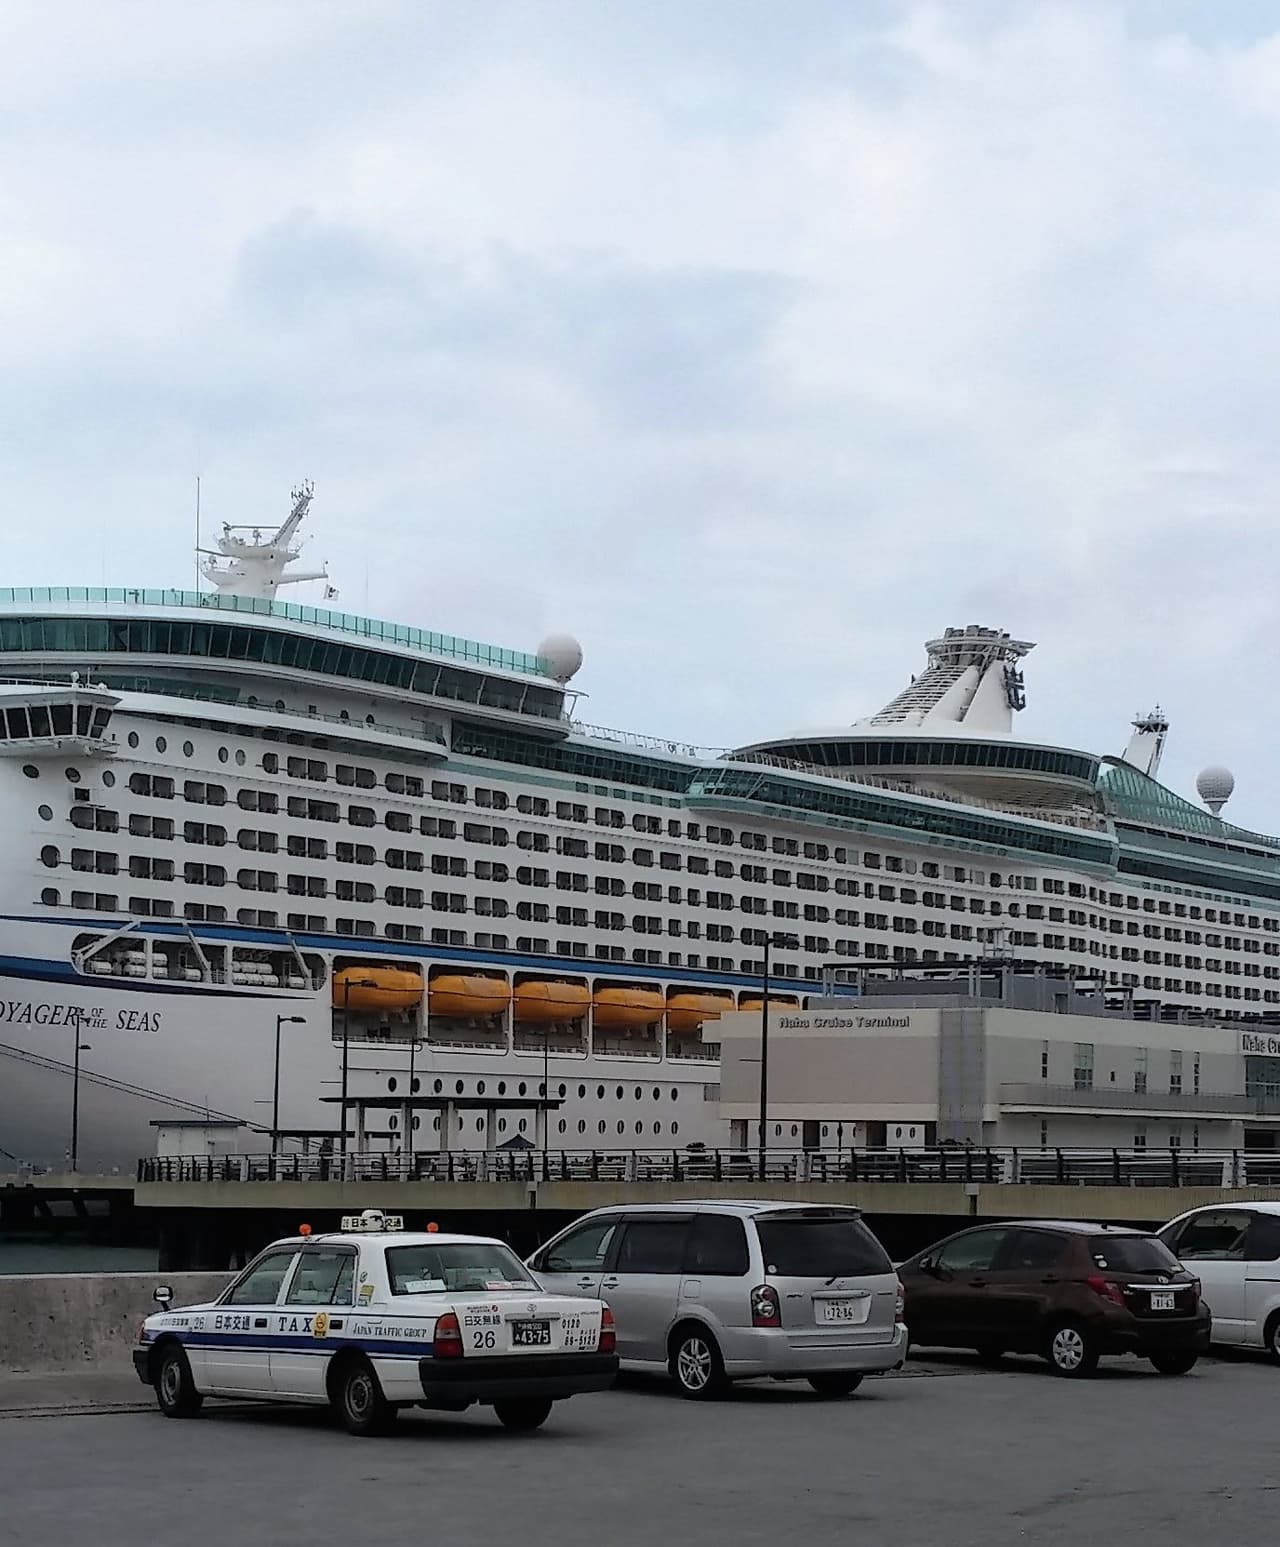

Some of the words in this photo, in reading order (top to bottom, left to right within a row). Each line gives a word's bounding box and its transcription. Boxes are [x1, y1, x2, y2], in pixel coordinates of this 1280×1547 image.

[91, 1007, 105, 1018] OF
[116, 1010, 161, 1032] SEAS
[780, 1016, 810, 1029] Naha
[814, 1016, 854, 1029] Cruise
[855, 1015, 910, 1029] Terminal
[215, 1314, 251, 1330] 日本交通
[473, 1330, 496, 1349] 26
